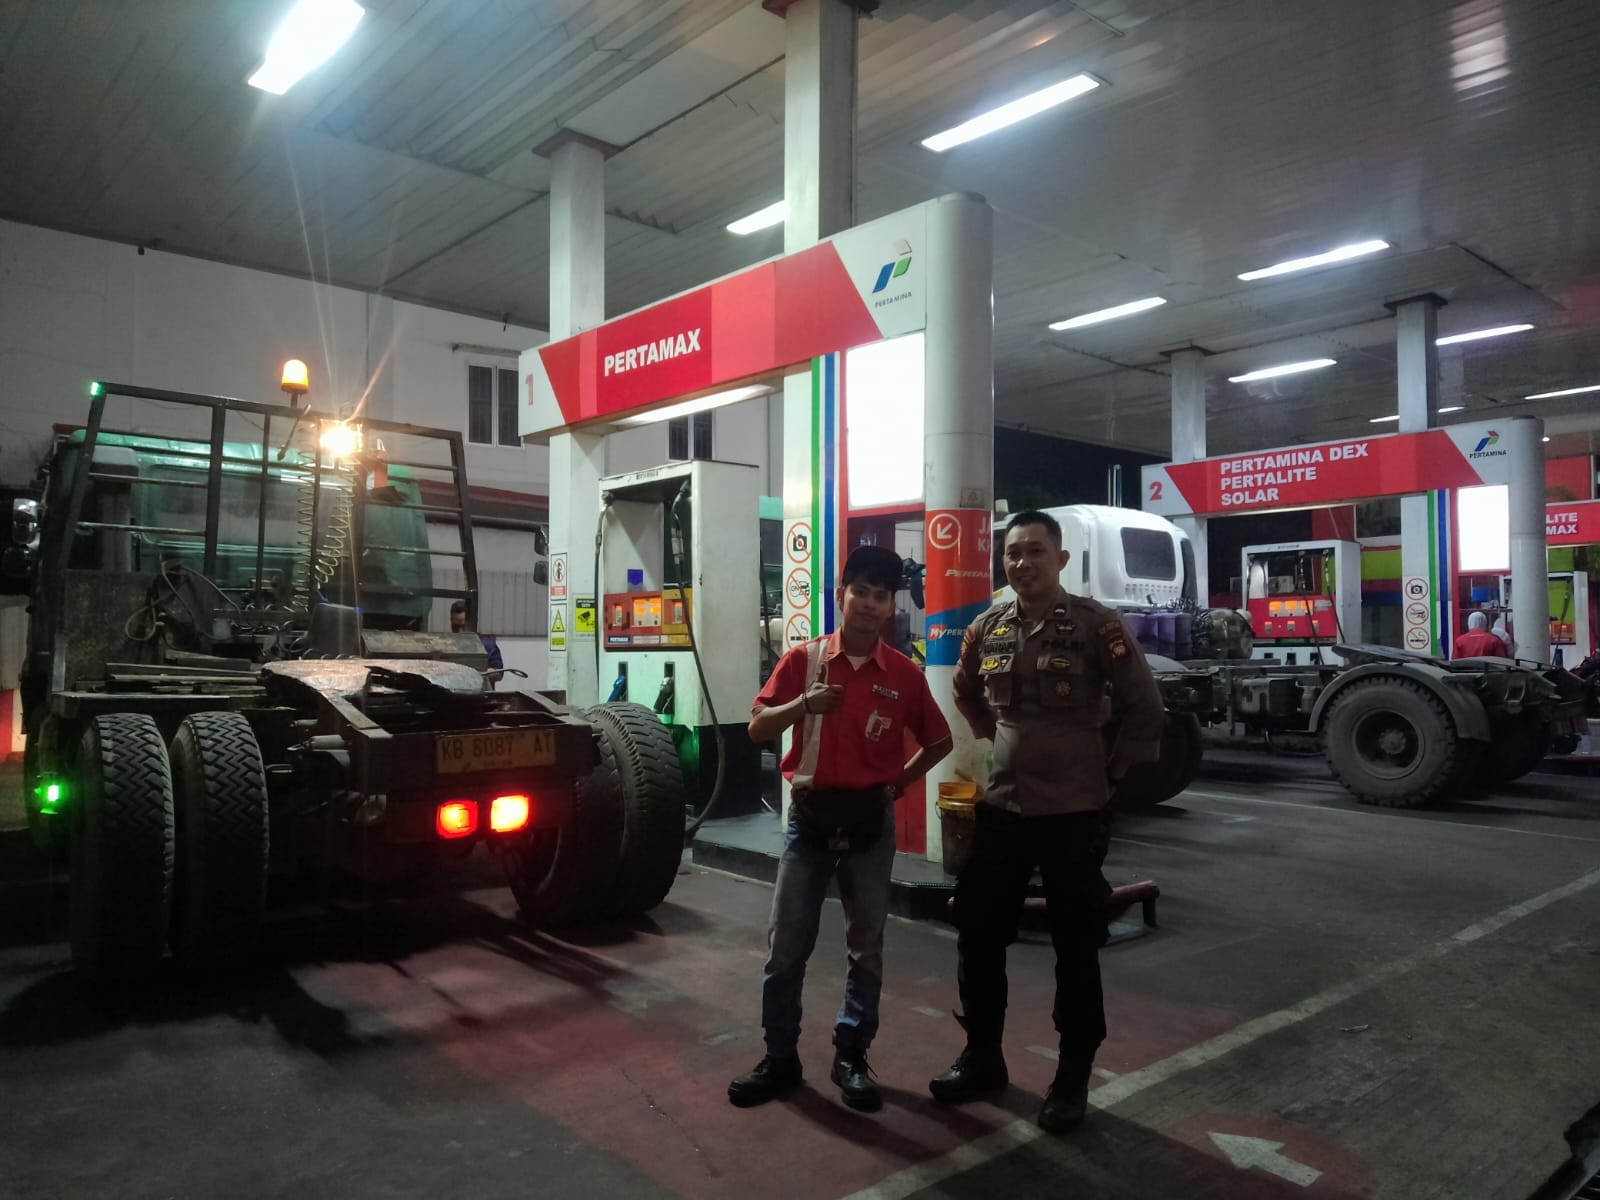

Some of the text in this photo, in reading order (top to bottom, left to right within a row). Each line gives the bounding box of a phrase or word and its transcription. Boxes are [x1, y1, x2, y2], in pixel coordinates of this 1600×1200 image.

[875, 291, 912, 308] PERTAMINA
[604, 327, 701, 377] PERTAMAX
[525, 373, 535, 406] 1
[1220, 443, 1369, 475] PERTAMINA DEX
[1469, 449, 1507, 459] PERTAMINA
[1220, 466, 1318, 490] PERTALITE
[1149, 481, 1163, 501] 2
[1221, 487, 1279, 506] SOLAR
[441, 739, 464, 761] KB
